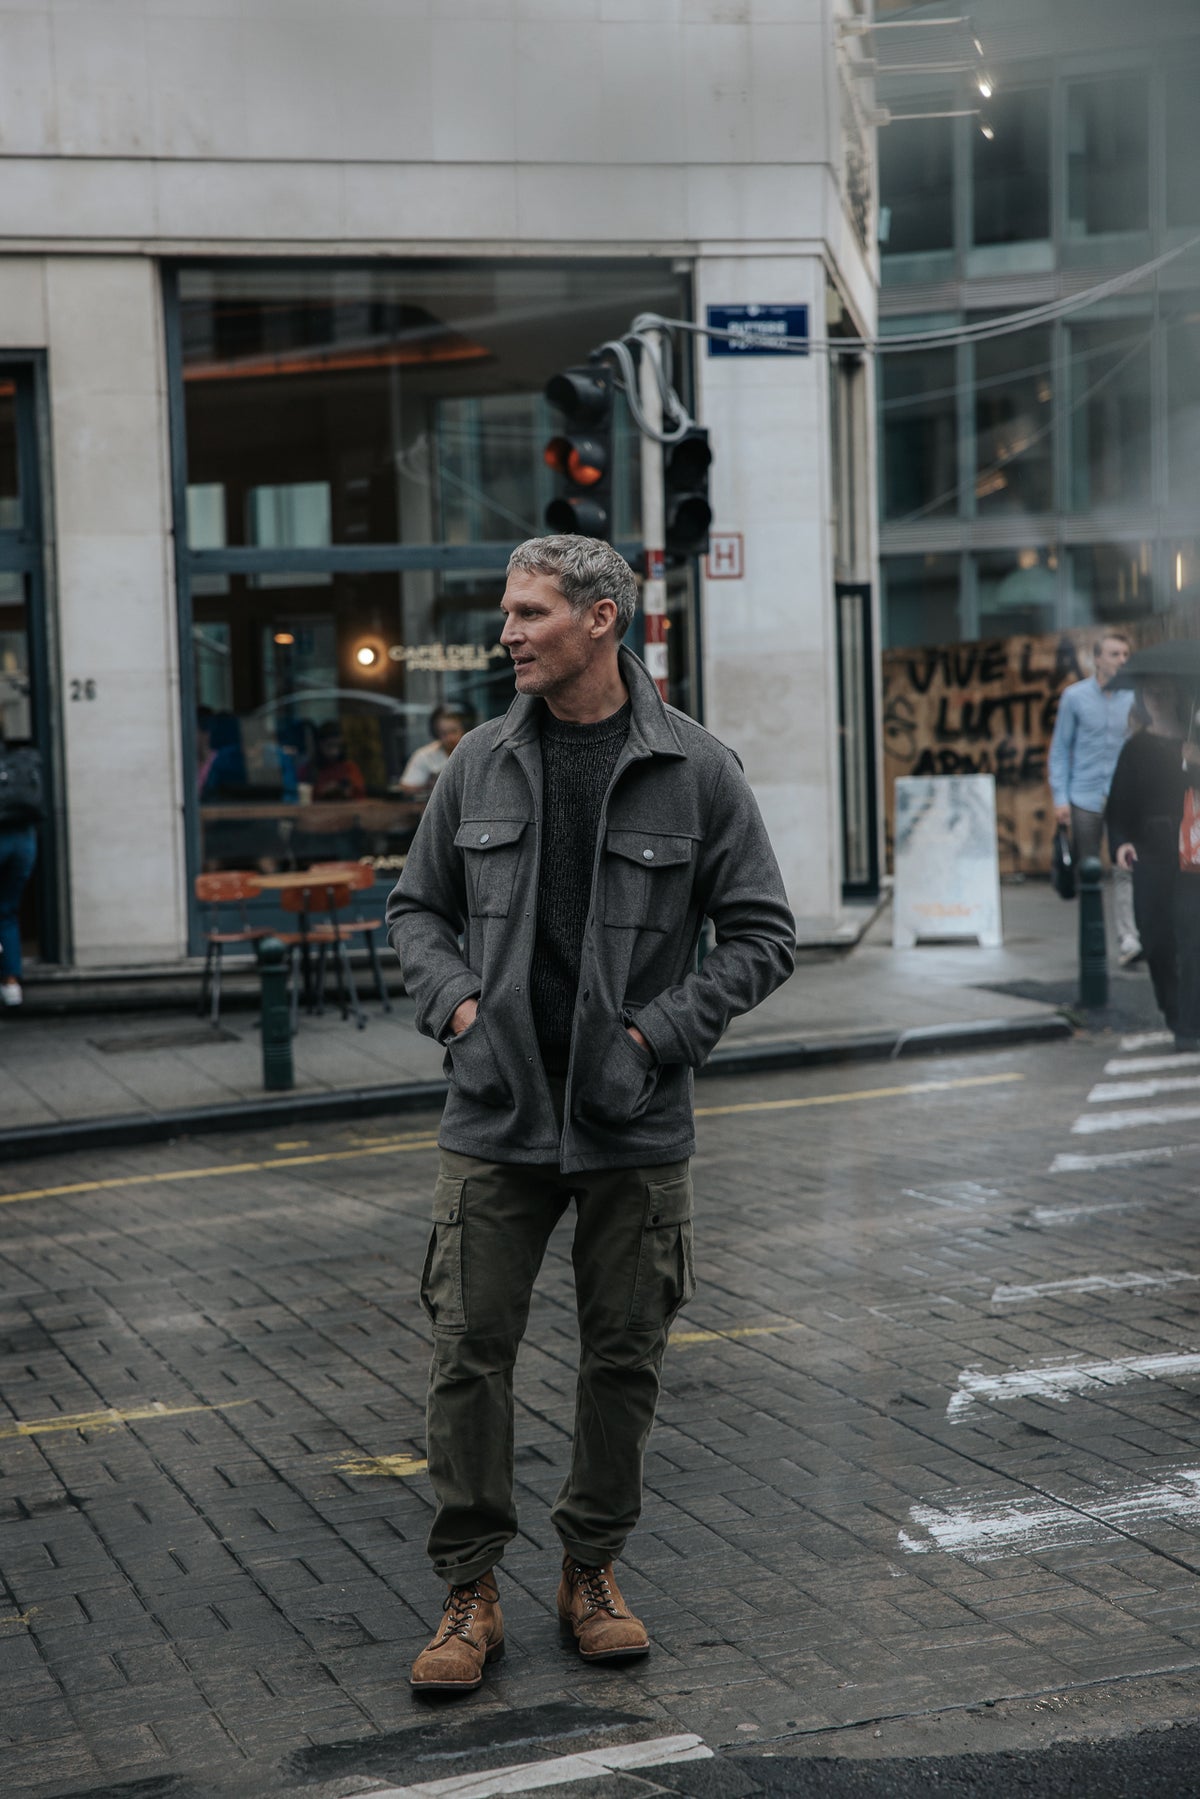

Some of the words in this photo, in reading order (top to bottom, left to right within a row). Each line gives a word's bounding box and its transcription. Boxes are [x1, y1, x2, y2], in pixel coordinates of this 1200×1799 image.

[715, 544, 735, 569] H
[906, 644, 1009, 694] VIVE
[70, 678, 97, 702] 26
